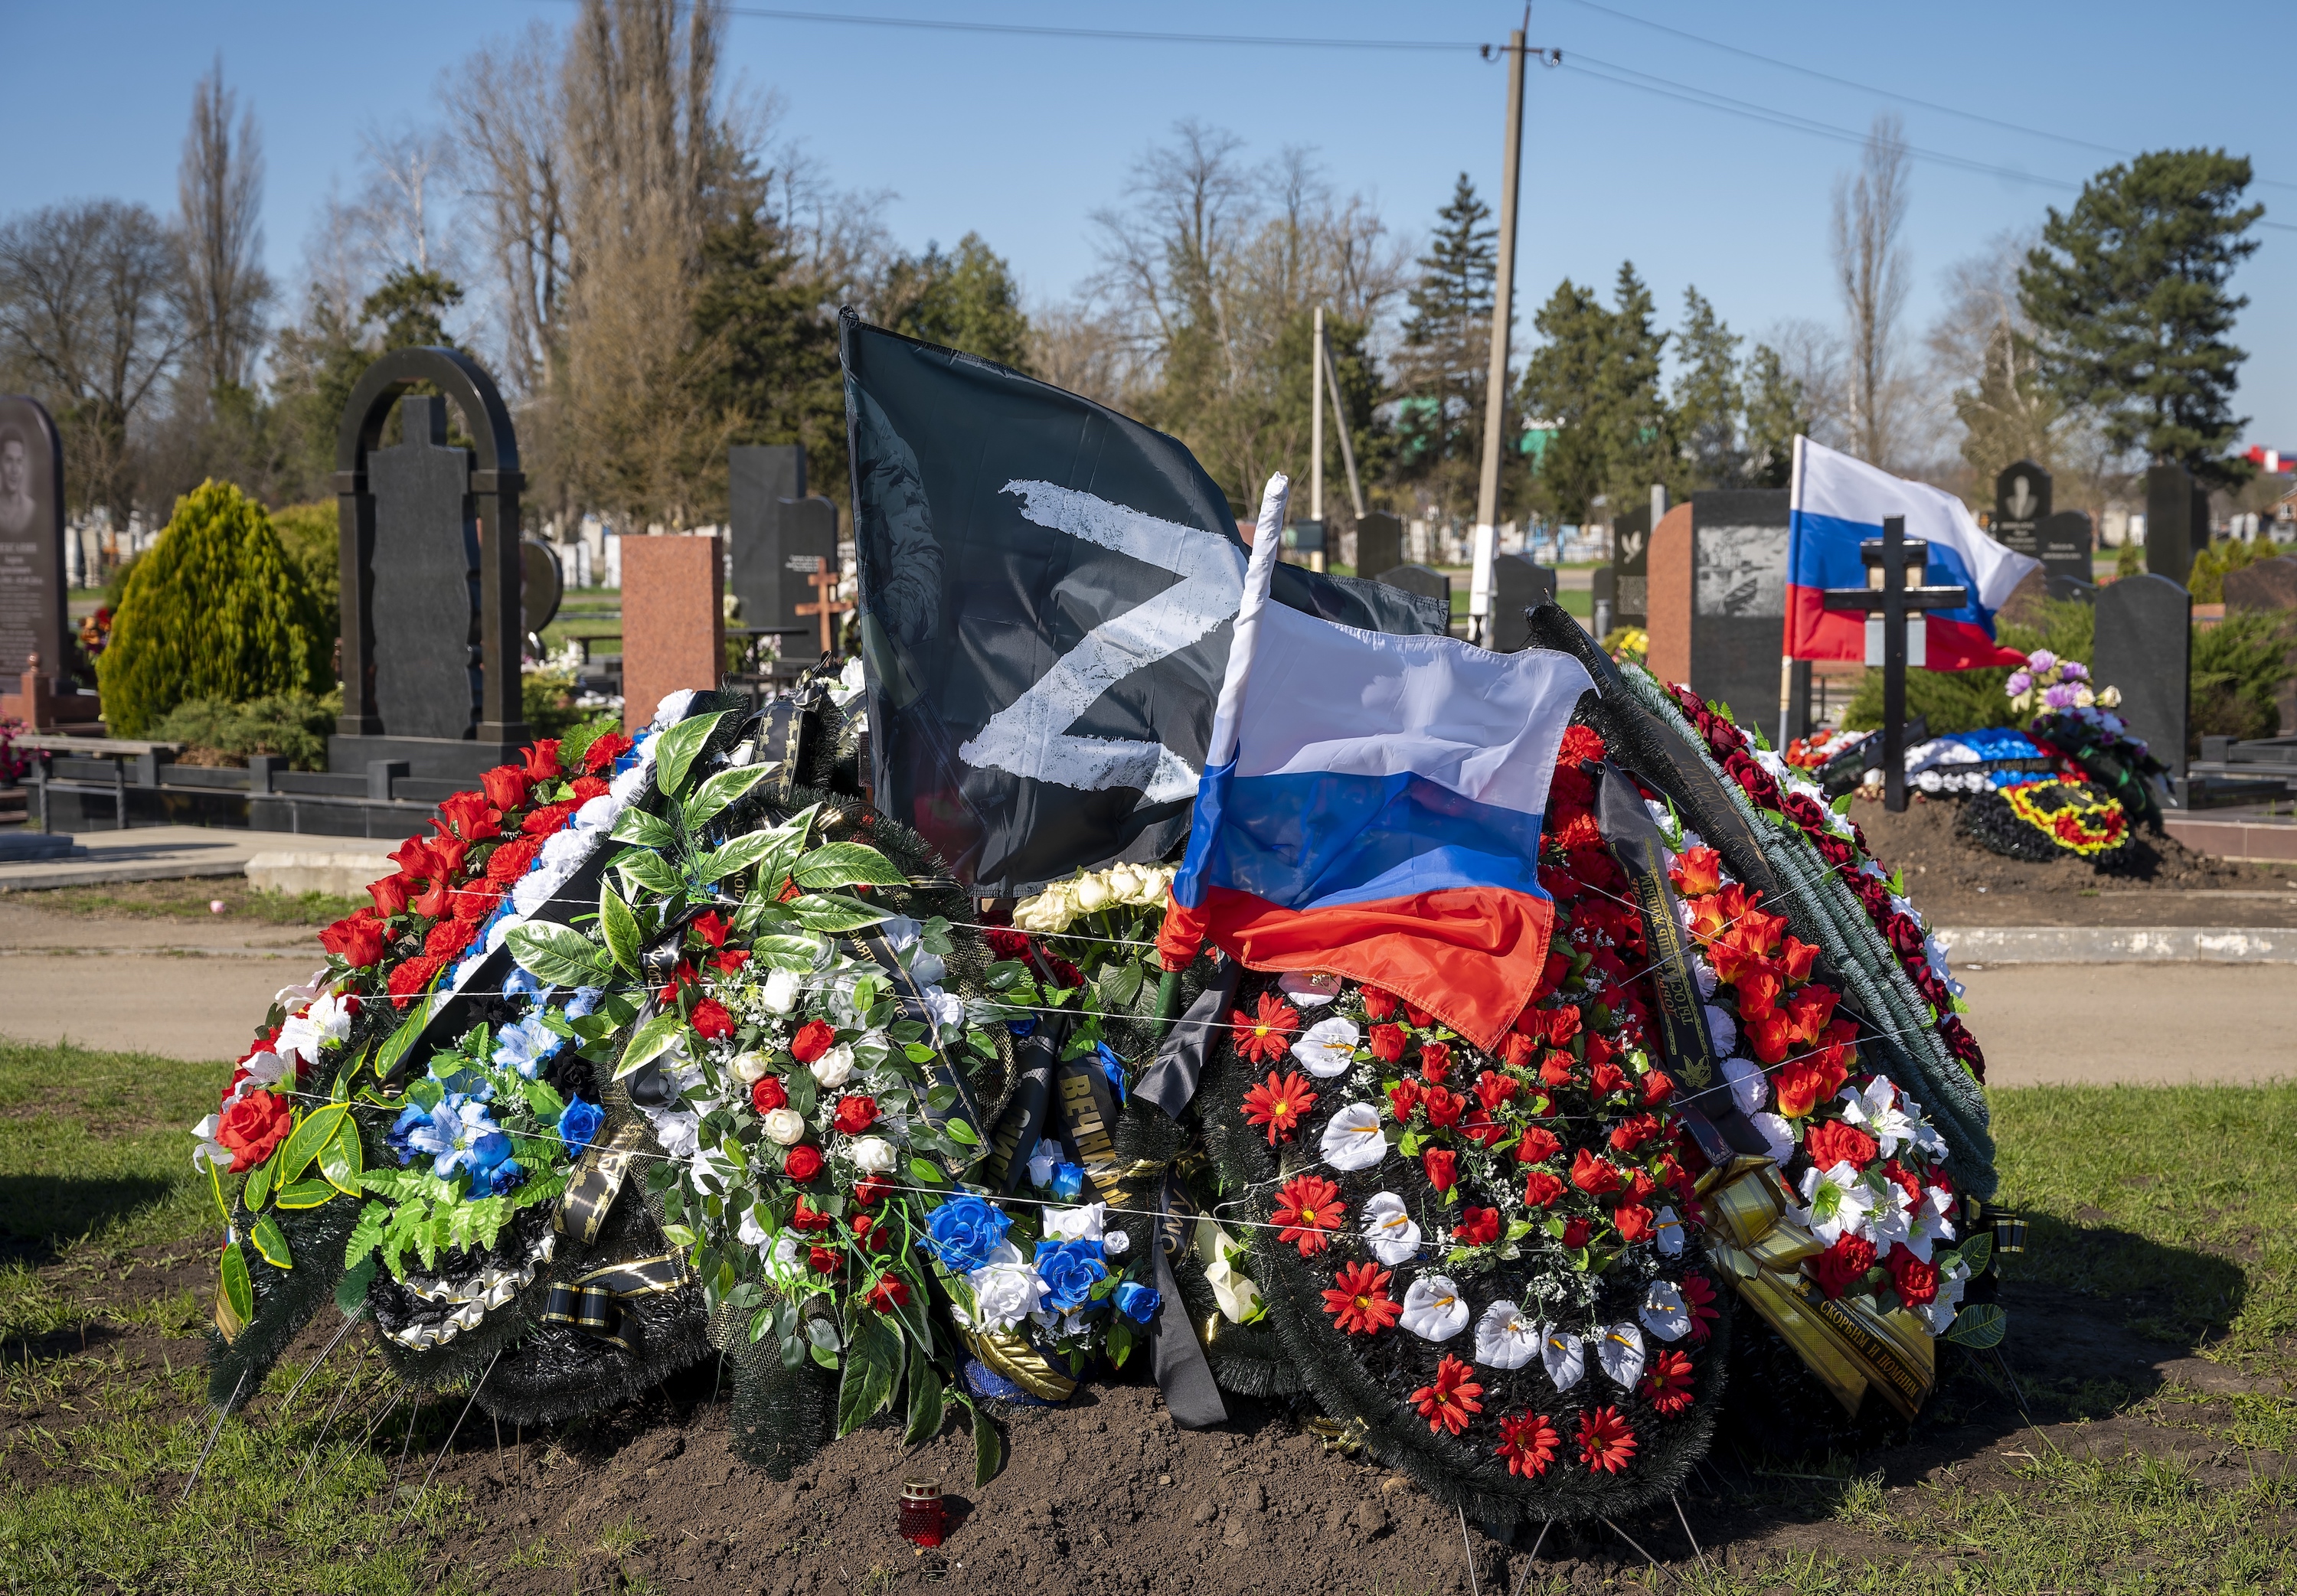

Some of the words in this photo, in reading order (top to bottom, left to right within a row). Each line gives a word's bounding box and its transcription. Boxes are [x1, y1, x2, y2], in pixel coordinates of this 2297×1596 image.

[959, 479, 1249, 804] Z
[847, 929, 878, 966] амят
[1656, 928, 1687, 1003] ОСТАВИШЬ
[1678, 1004, 1694, 1026] ТЫ
[1820, 1300, 1871, 1349] СКОРБИМ
[1867, 1343, 1882, 1359] И
[1877, 1353, 1920, 1399] ПОМНИМ
